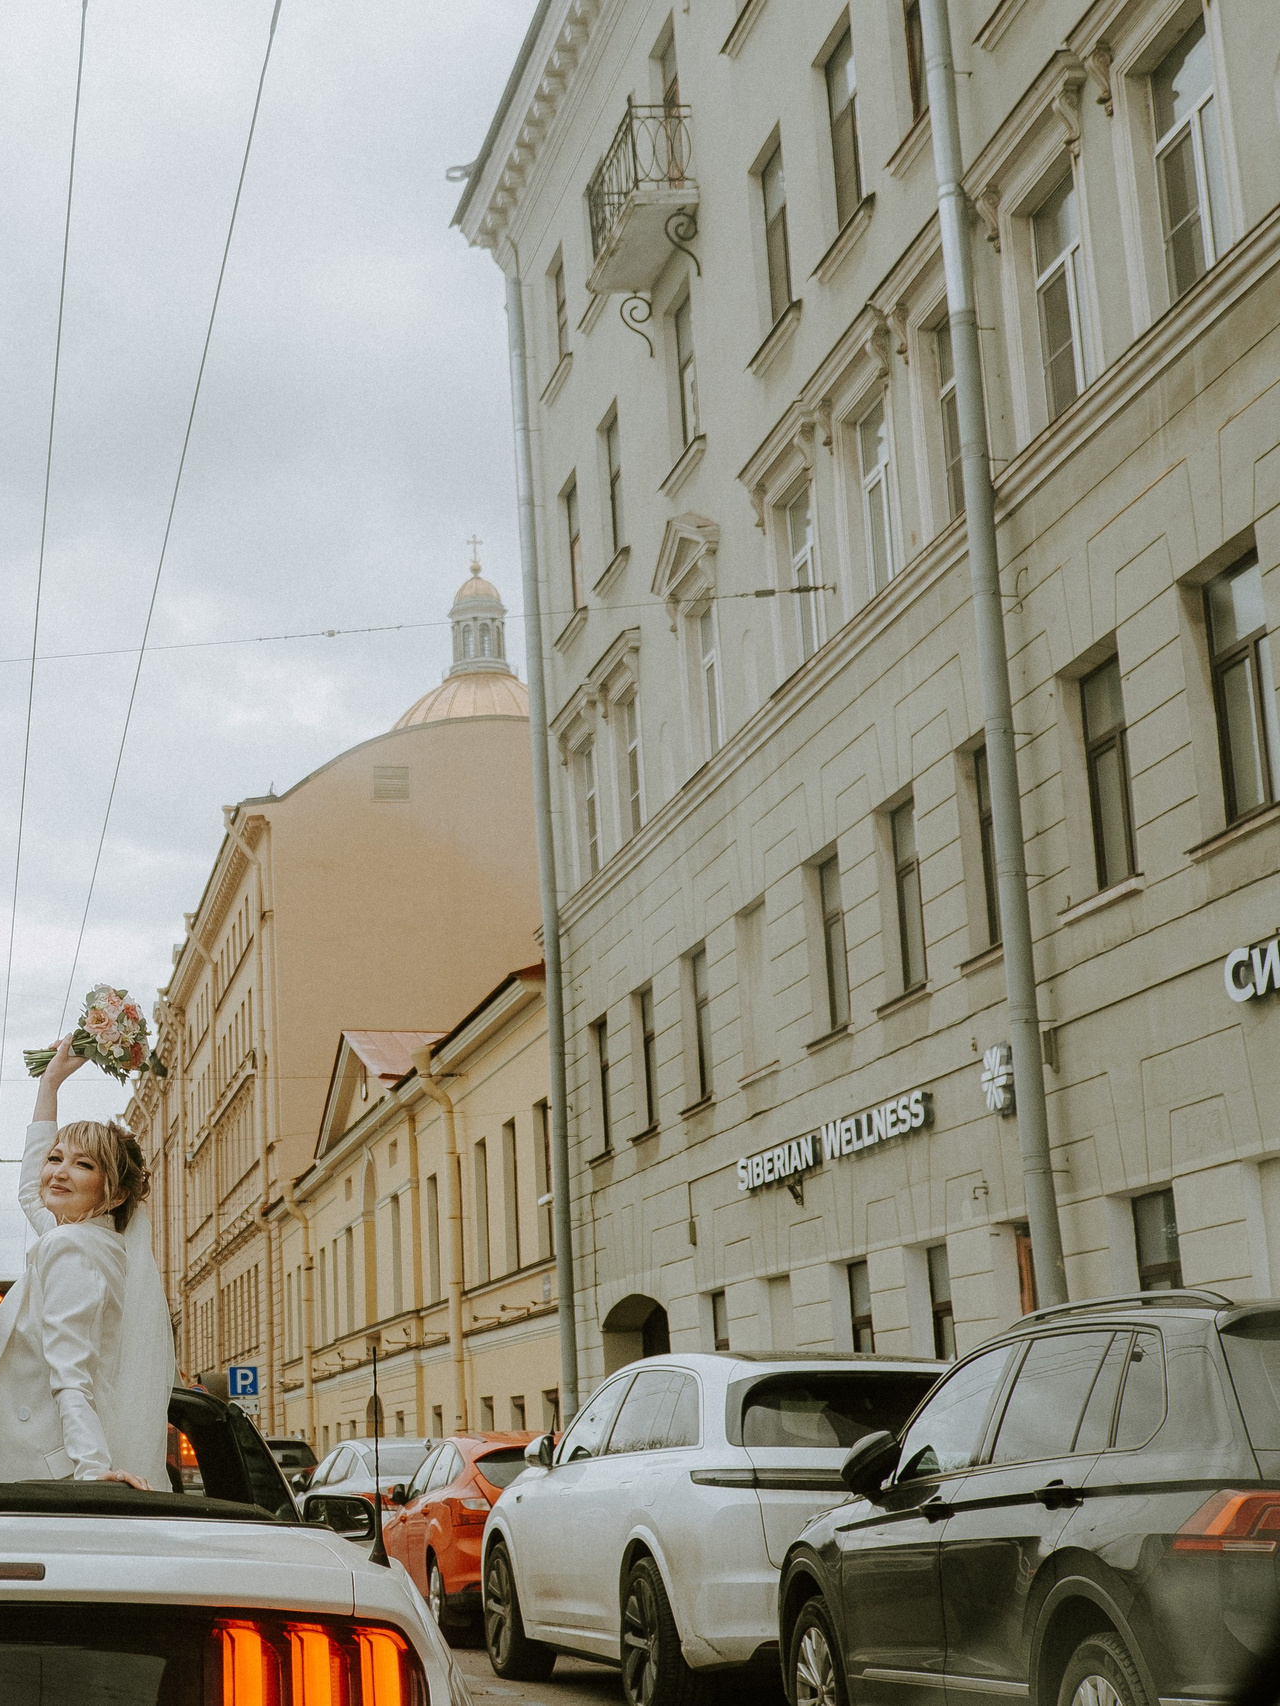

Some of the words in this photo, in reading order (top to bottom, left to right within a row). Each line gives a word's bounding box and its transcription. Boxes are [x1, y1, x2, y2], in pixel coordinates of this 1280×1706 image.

[737, 1135, 814, 1191] SIBERIAN
[820, 1090, 925, 1160] WELLNESS
[236, 1369, 254, 1394] P
